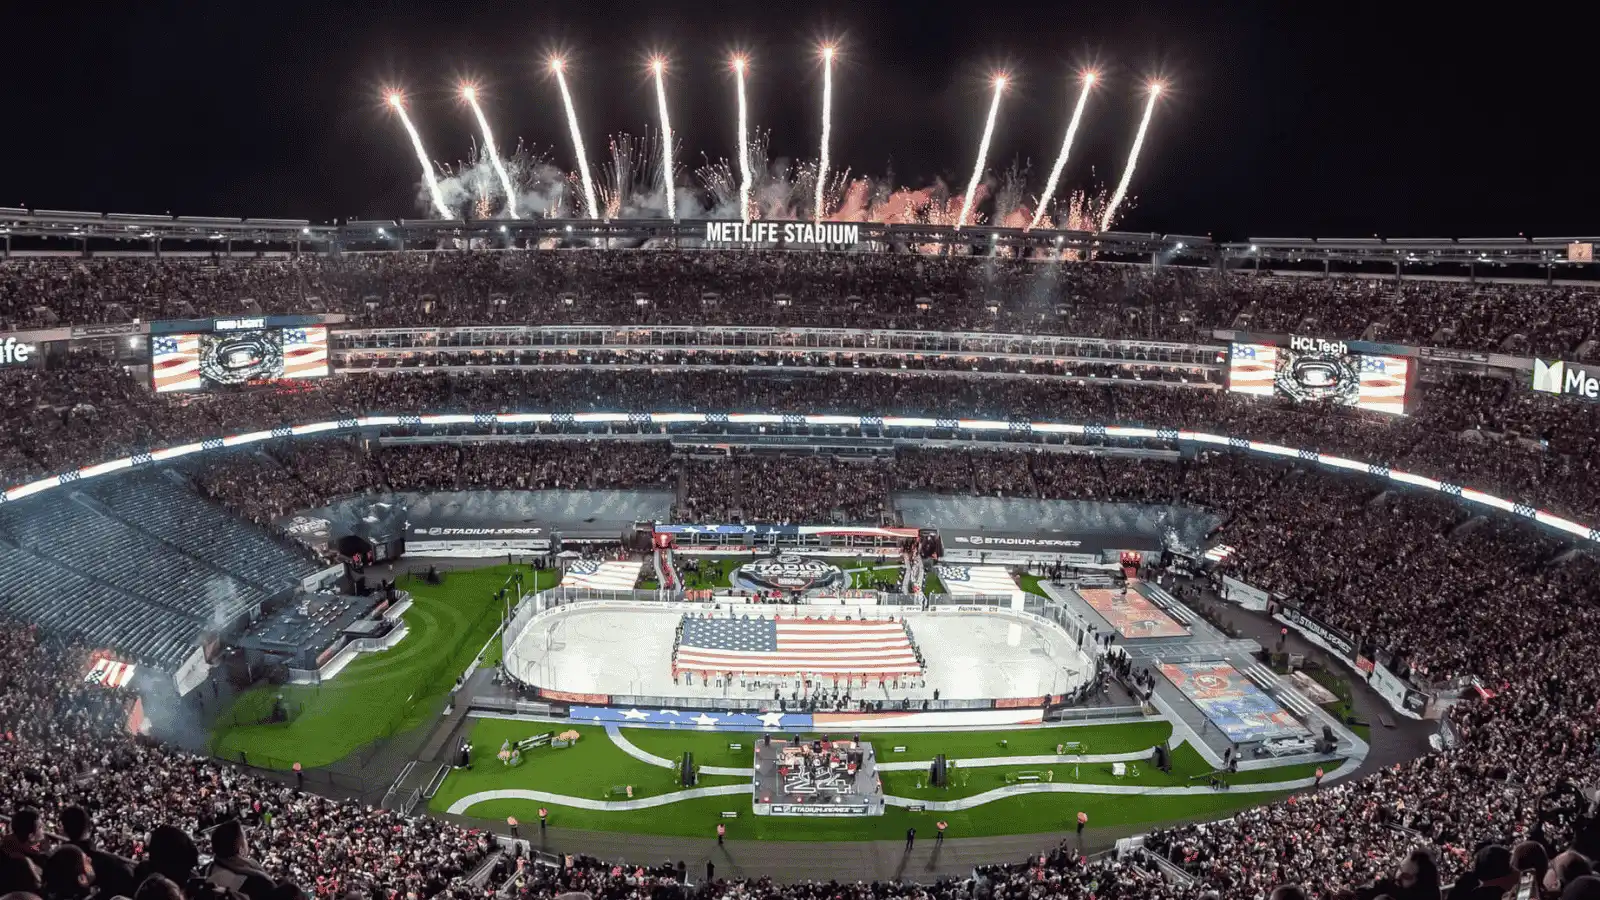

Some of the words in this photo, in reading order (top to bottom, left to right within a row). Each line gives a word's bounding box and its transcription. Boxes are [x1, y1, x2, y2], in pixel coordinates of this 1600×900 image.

[706, 222, 778, 242] METLIFE
[784, 224, 859, 244] STADIUM
[1290, 336, 1348, 354] HCLTech
[1564, 368, 1600, 398] Me
[495, 527, 542, 535] SERIES
[984, 537, 1036, 545] STADIUM
[1036, 539, 1082, 547] SERIES
[740, 564, 842, 574] STADIUM
[1300, 616, 1328, 639] STADIUM
[1327, 634, 1352, 653] SERIES
